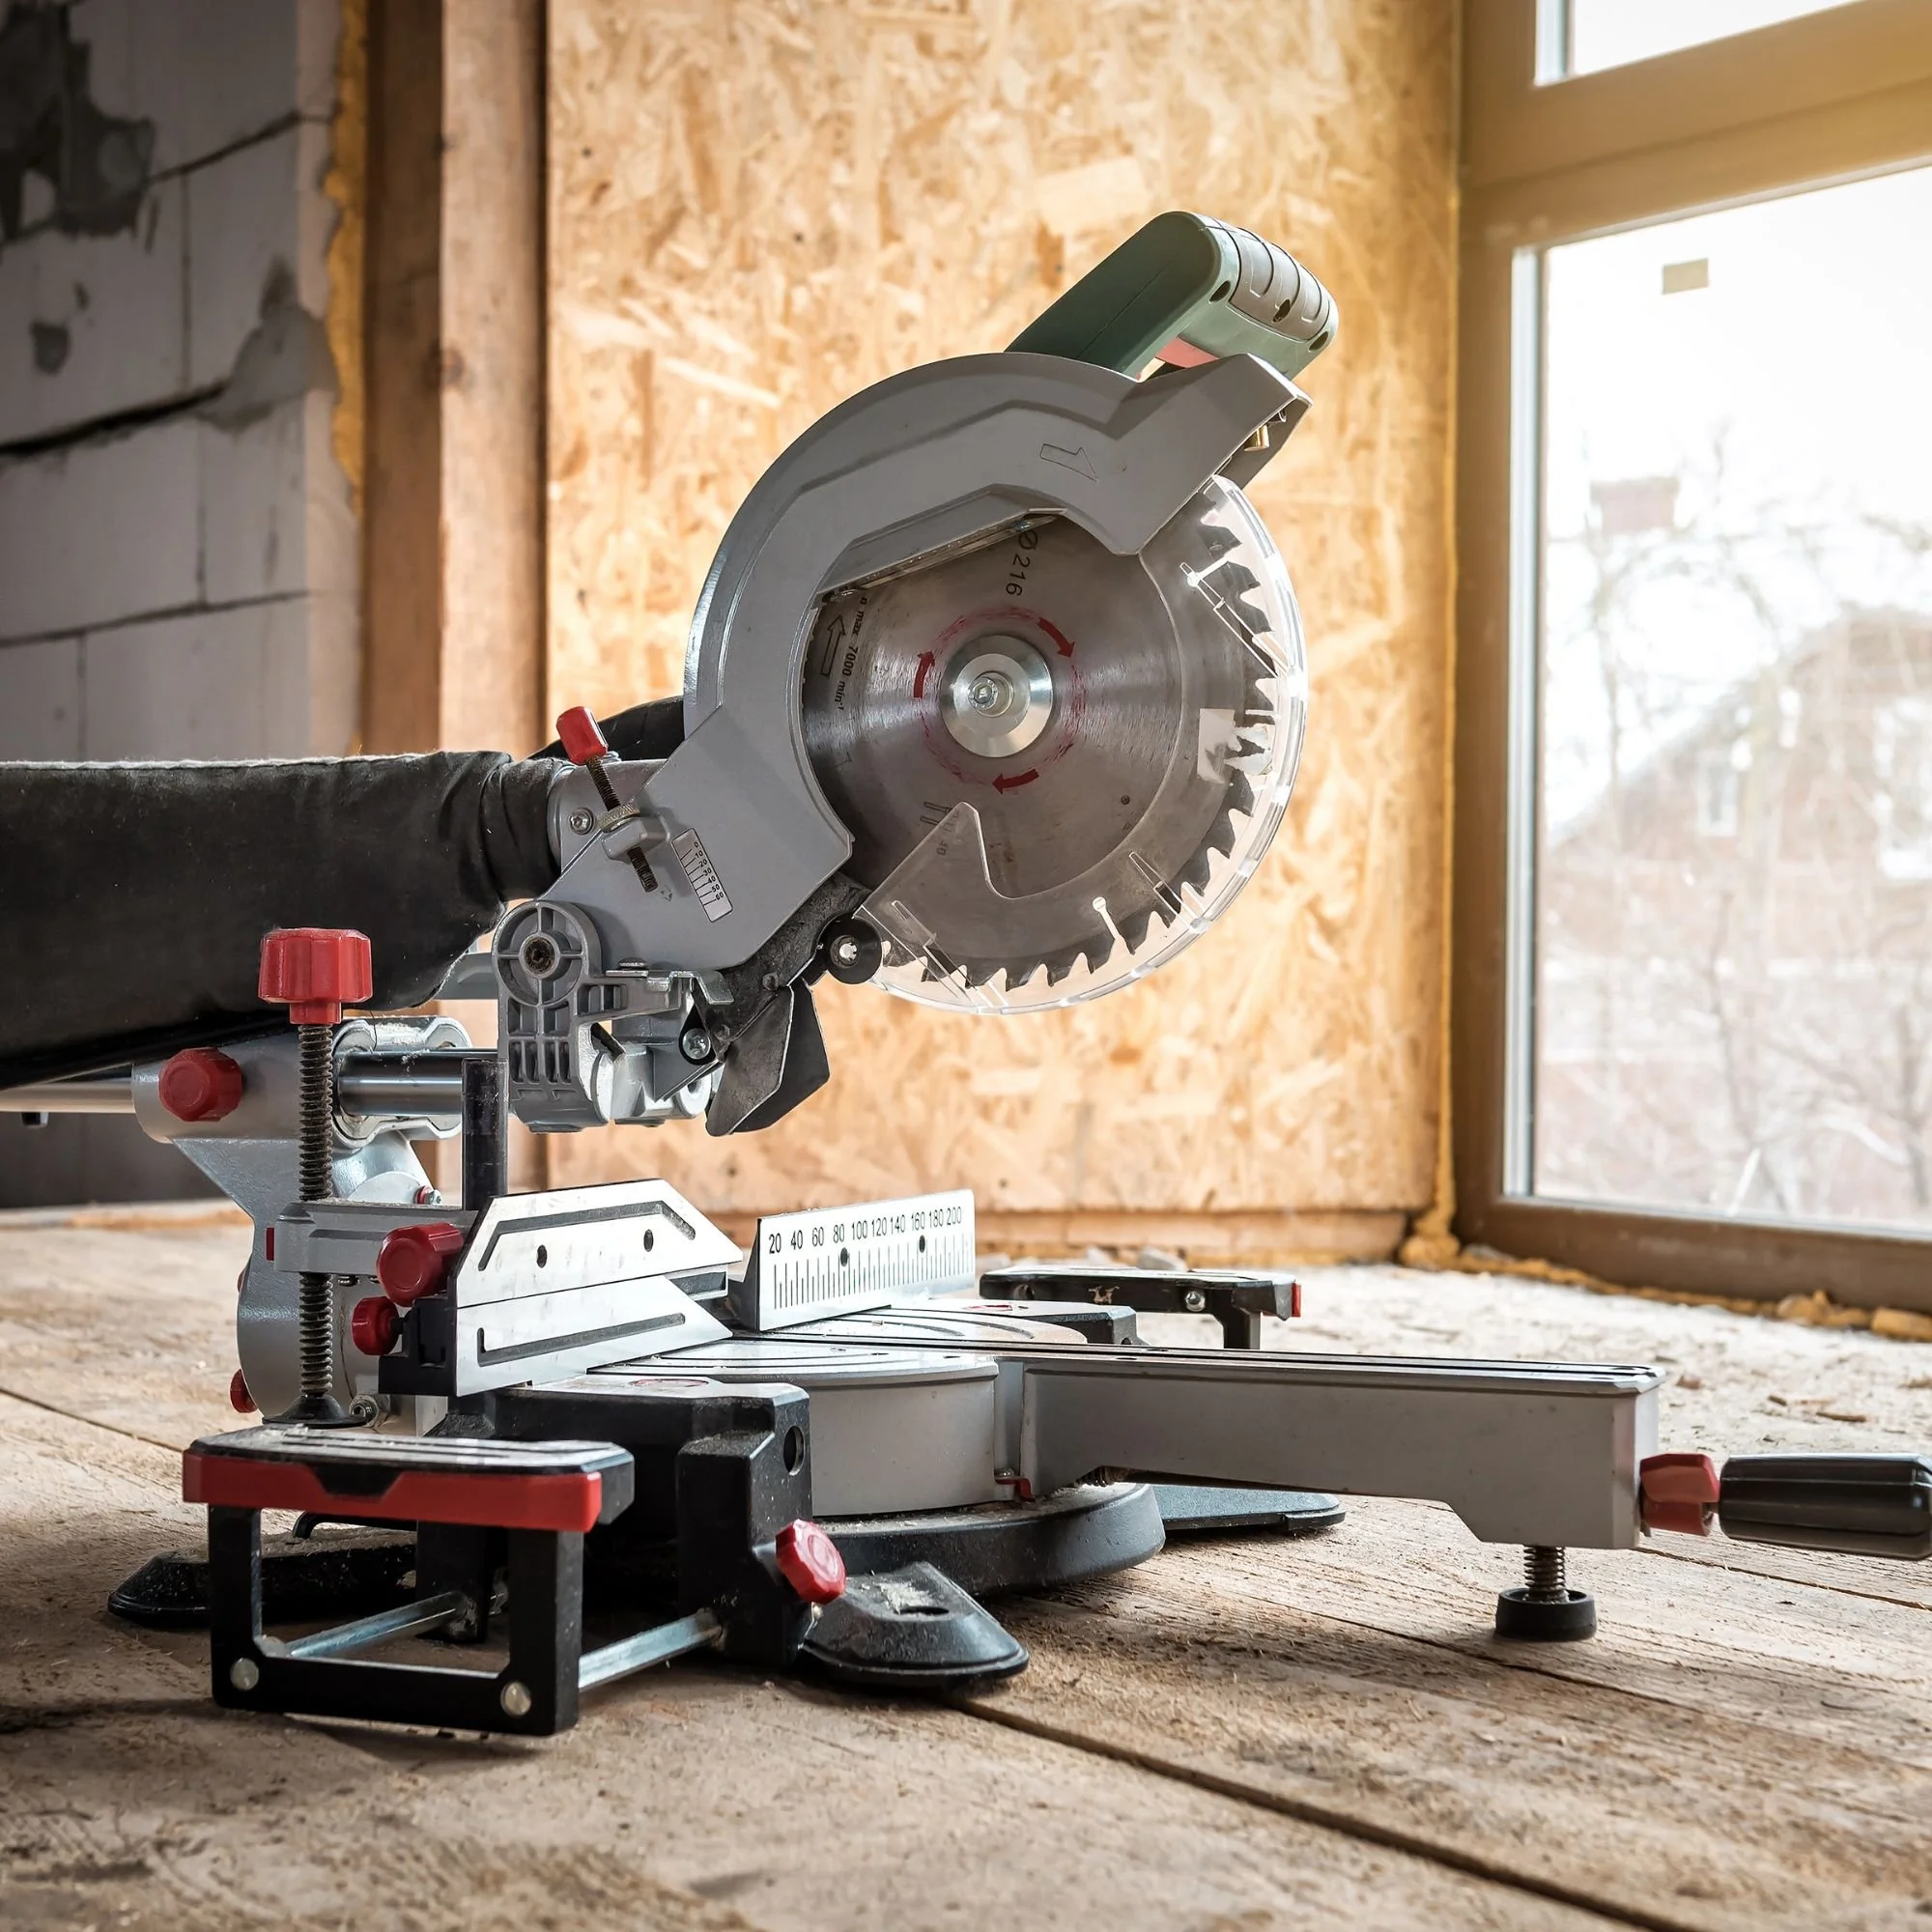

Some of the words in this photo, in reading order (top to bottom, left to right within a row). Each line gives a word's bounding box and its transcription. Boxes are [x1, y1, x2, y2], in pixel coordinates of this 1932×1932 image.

[852, 611, 865, 636] max
[841, 645, 859, 677] 7000
[699, 859, 707, 867] 20
[703, 867, 711, 876] 30
[712, 884, 720, 893] 50
[769, 1233, 781, 1254] 20
[790, 1230, 804, 1250] 40
[811, 1226, 825, 1246] 60
[833, 1224, 845, 1243] 80
[851, 1220, 868, 1240] 100
[871, 1217, 887, 1236] 120
[891, 1214, 906, 1234] 140
[911, 1211, 925, 1231] 160
[928, 1208, 944, 1229] 180
[946, 1206, 962, 1226] 200
